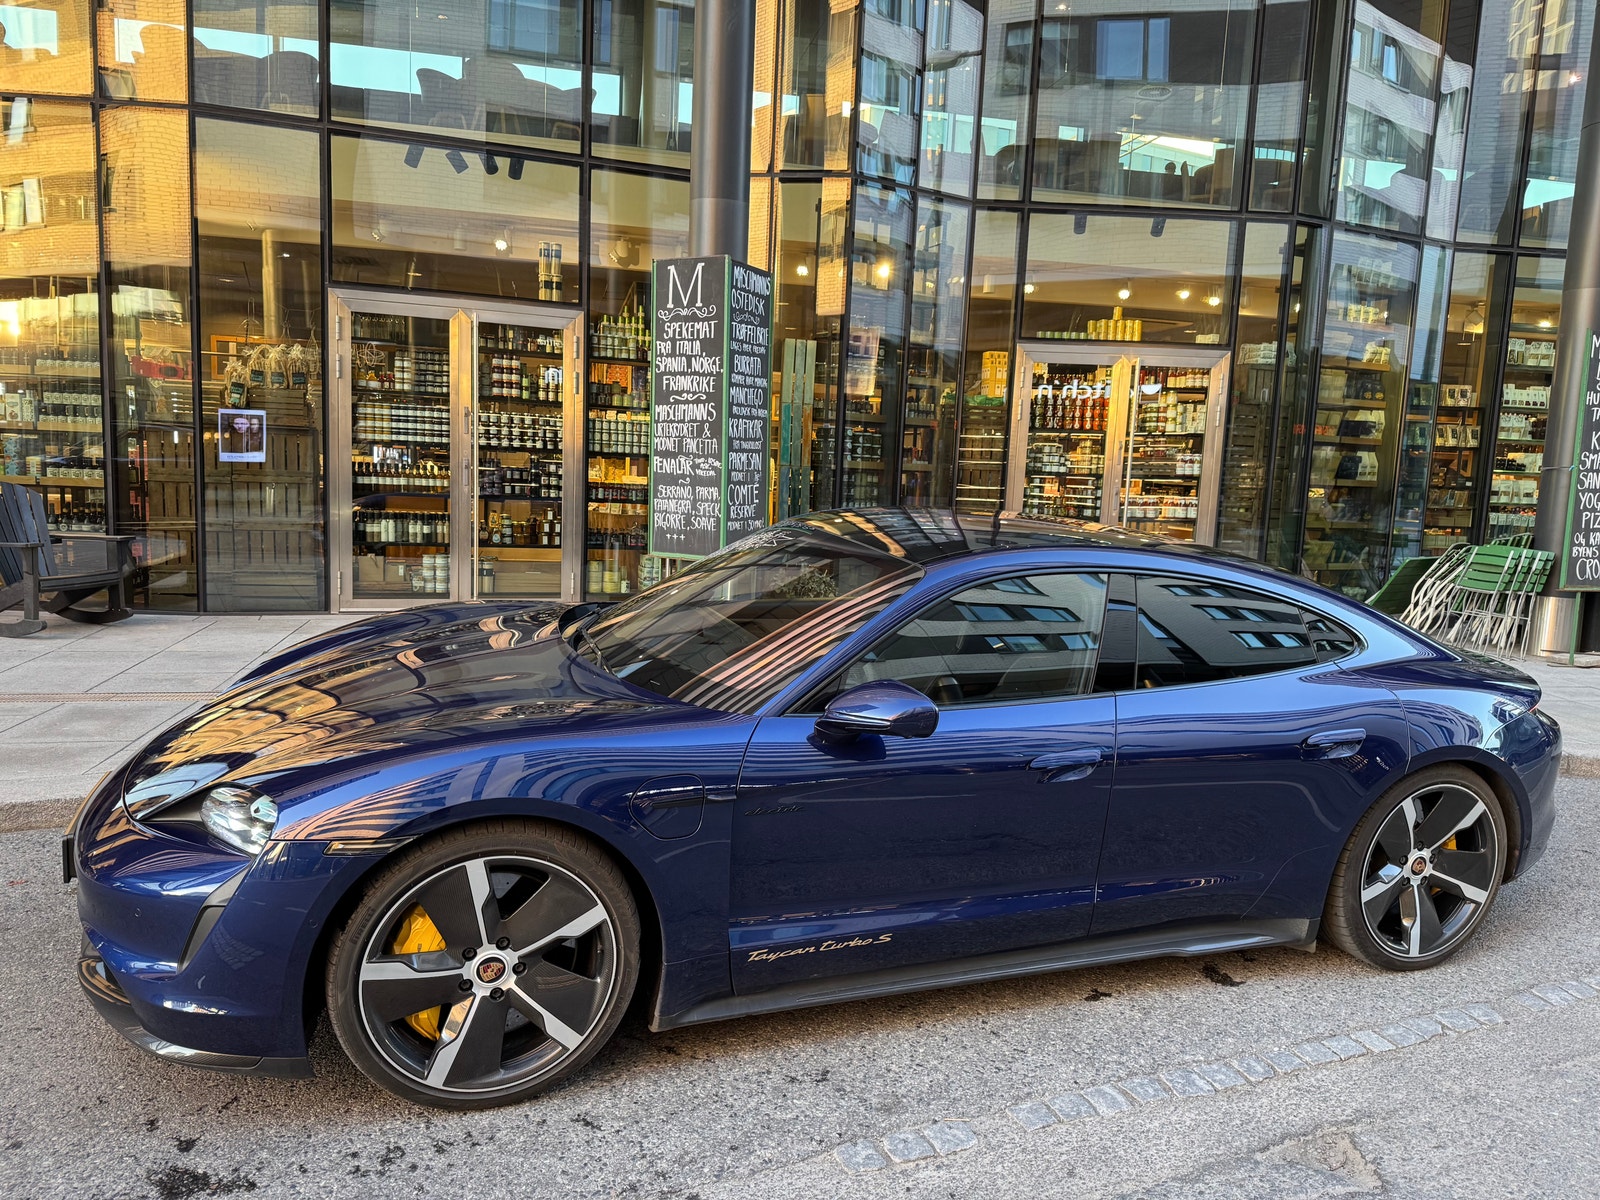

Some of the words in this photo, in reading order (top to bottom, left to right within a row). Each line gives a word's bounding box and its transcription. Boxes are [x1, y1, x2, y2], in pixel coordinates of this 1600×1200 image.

[667, 262, 705, 308] M
[731, 289, 765, 316] OSTEDISK
[664, 320, 718, 339] SPEKEMAT
[656, 341, 671, 355] FRA
[656, 357, 692, 373] SPANIA,
[663, 375, 716, 393] FRANKRIKE
[655, 403, 716, 422] MASCHMANNS
[703, 423, 711, 438] &
[729, 417, 764, 441] KRAFTKAR
[654, 437, 681, 452] MODNET
[683, 438, 718, 454] PANCETTA
[729, 451, 762, 471] PARMESAN
[657, 485, 693, 500] SERRANO,
[727, 482, 760, 505] COMTÉ
[690, 516, 717, 531] SOAVE
[1574, 531, 1586, 546] OG
[1572, 545, 1598, 558] BYENS
[747, 945, 816, 963] Taycan
[873, 933, 893, 944] S
